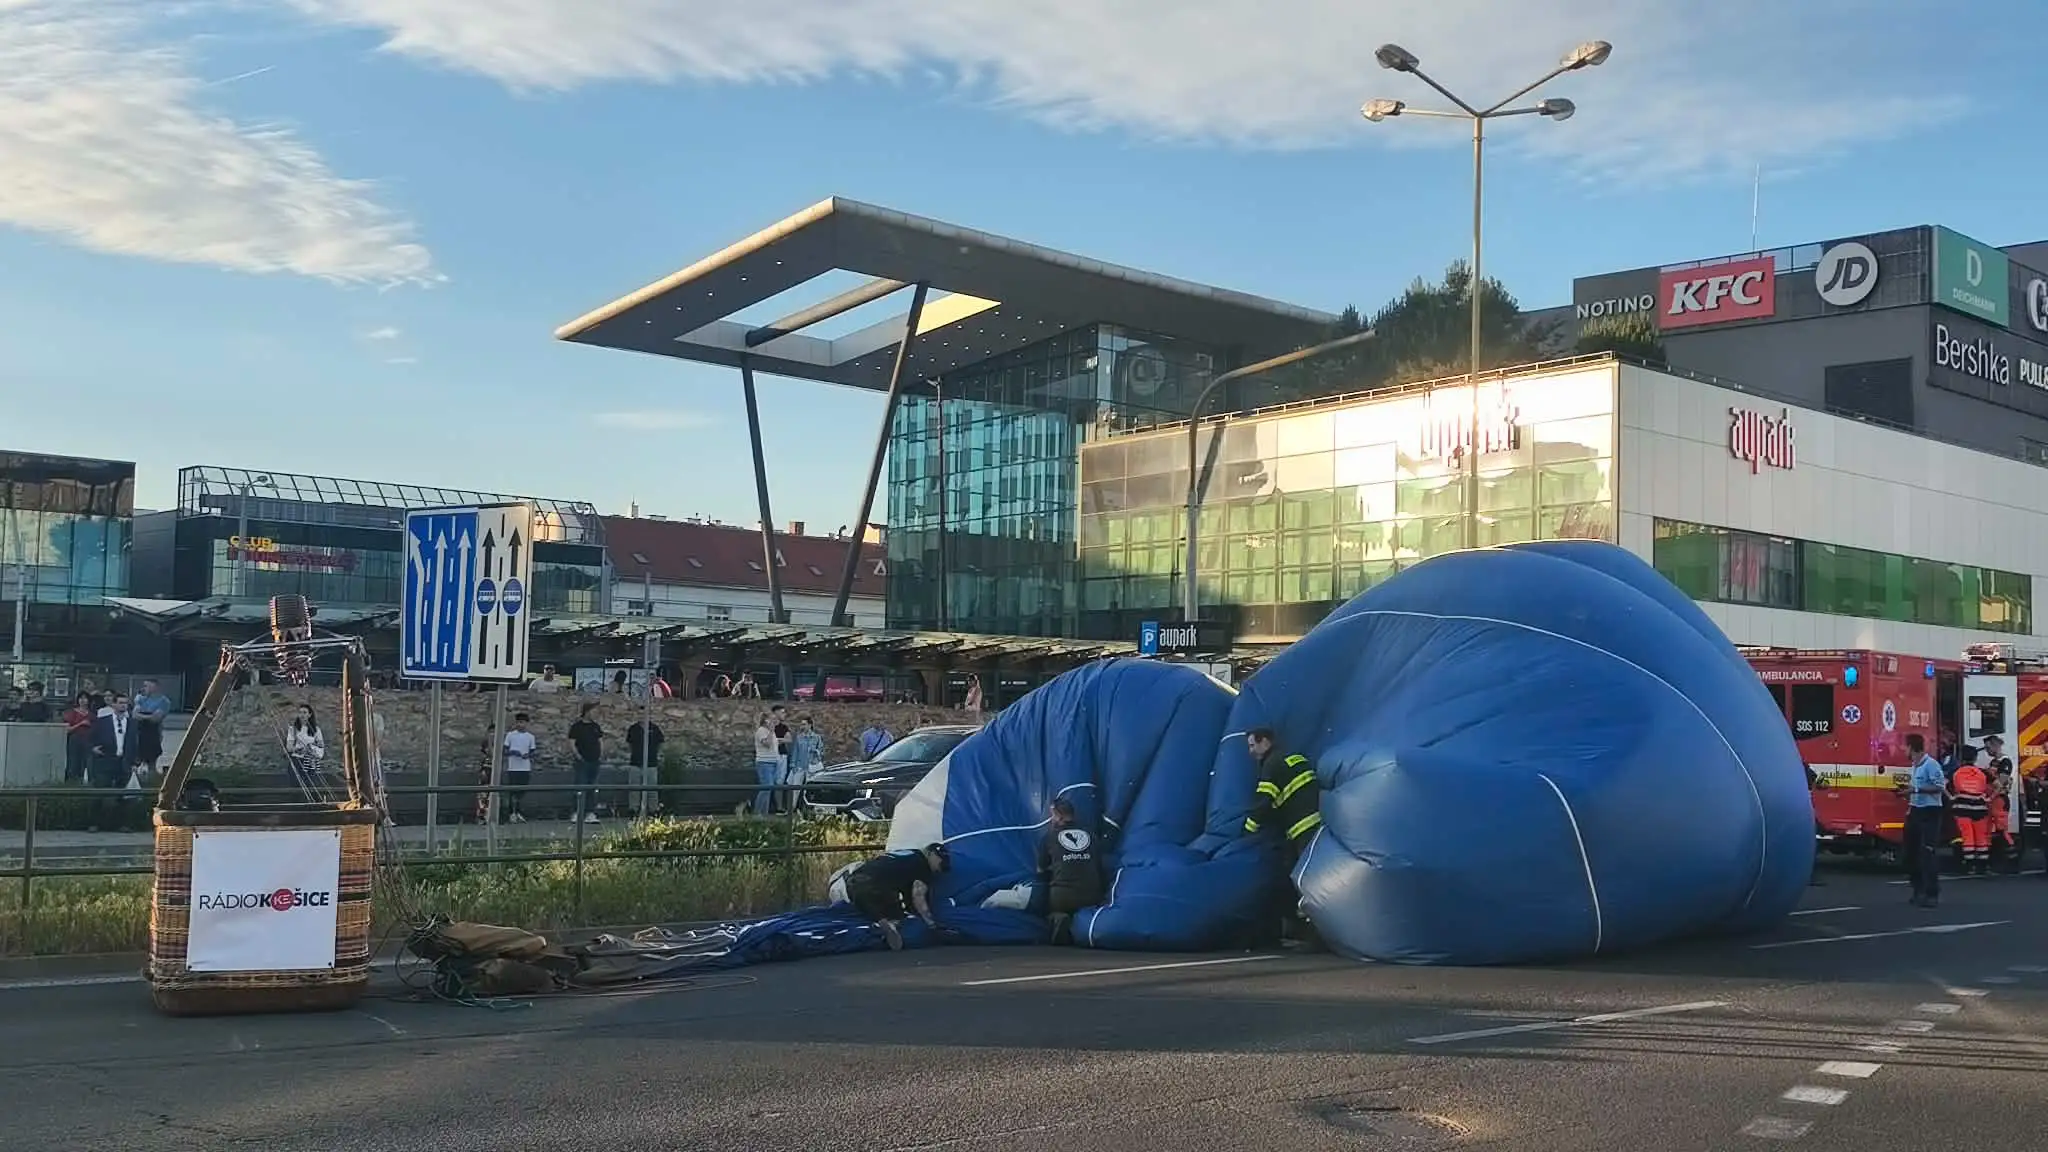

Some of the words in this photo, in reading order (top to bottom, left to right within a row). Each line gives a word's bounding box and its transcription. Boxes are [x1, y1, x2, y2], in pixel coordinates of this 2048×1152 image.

[1823, 256, 1870, 292] JD
[1576, 294, 1654, 320] NOTINO
[1668, 271, 1764, 315] KFC
[1936, 324, 2009, 384] Bershka
[1159, 624, 1197, 651] aupark
[1796, 720, 1813, 732] SOS
[1814, 720, 1829, 732] 112
